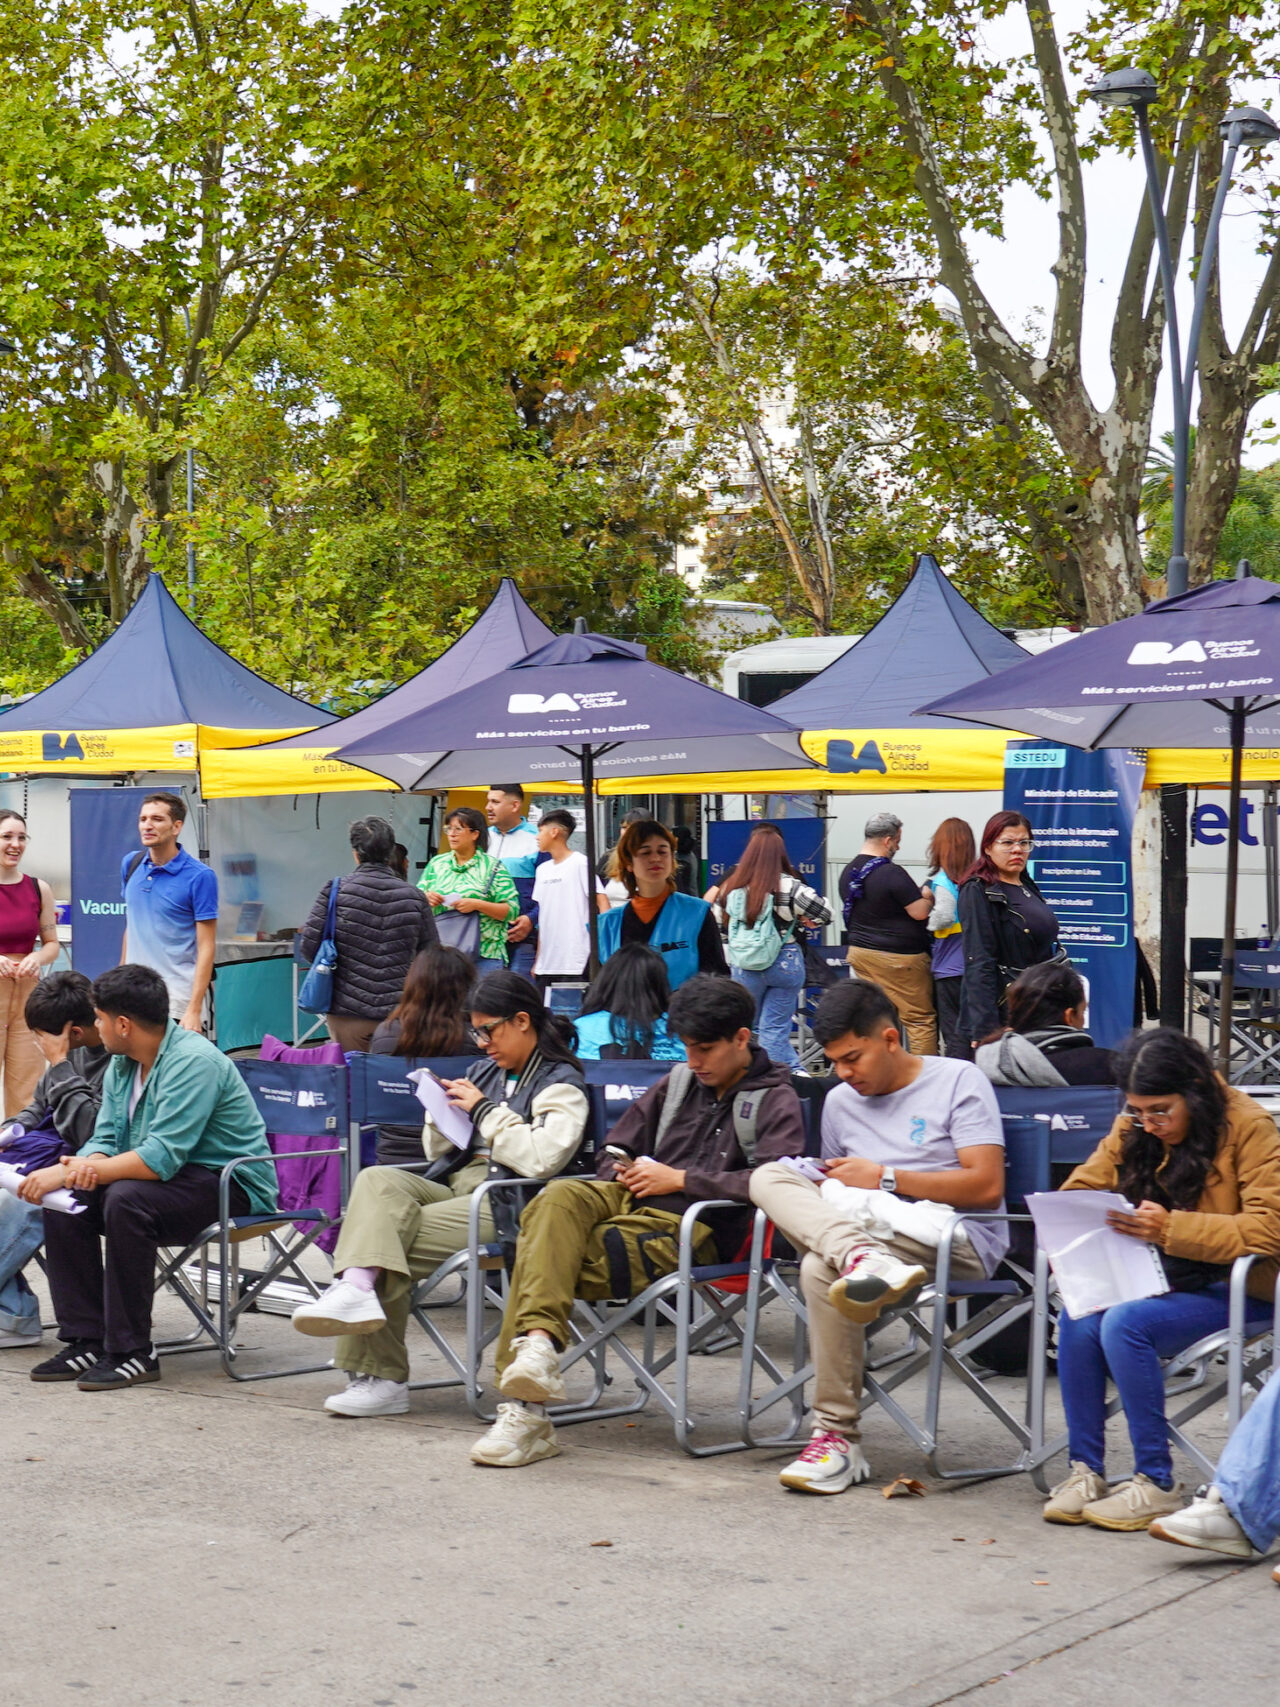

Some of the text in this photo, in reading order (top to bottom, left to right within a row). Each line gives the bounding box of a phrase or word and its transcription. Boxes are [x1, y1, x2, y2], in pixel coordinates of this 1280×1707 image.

[1127, 640, 1255, 665] BA Buenos
[1210, 649, 1261, 659] Ciudad
[1081, 677, 1273, 695] Más servicios en tu barrio
[508, 691, 618, 714] BA Buenos
[583, 699, 627, 709] Ciudad
[476, 723, 650, 739] Más servicios en tu barrio
[42, 733, 85, 761] BA
[827, 739, 922, 774] BA Buenos
[888, 752, 917, 760] Aires
[1014, 753, 1057, 762] SSTEDU
[1222, 753, 1229, 762] y
[313, 765, 326, 773] en
[328, 764, 338, 772] tu
[891, 761, 929, 771] Ciudad
[1024, 789, 1118, 797] Ministerio de Educación
[711, 864, 724, 876] Si
[799, 862, 816, 874] tu
[605, 1084, 632, 1100] BA
